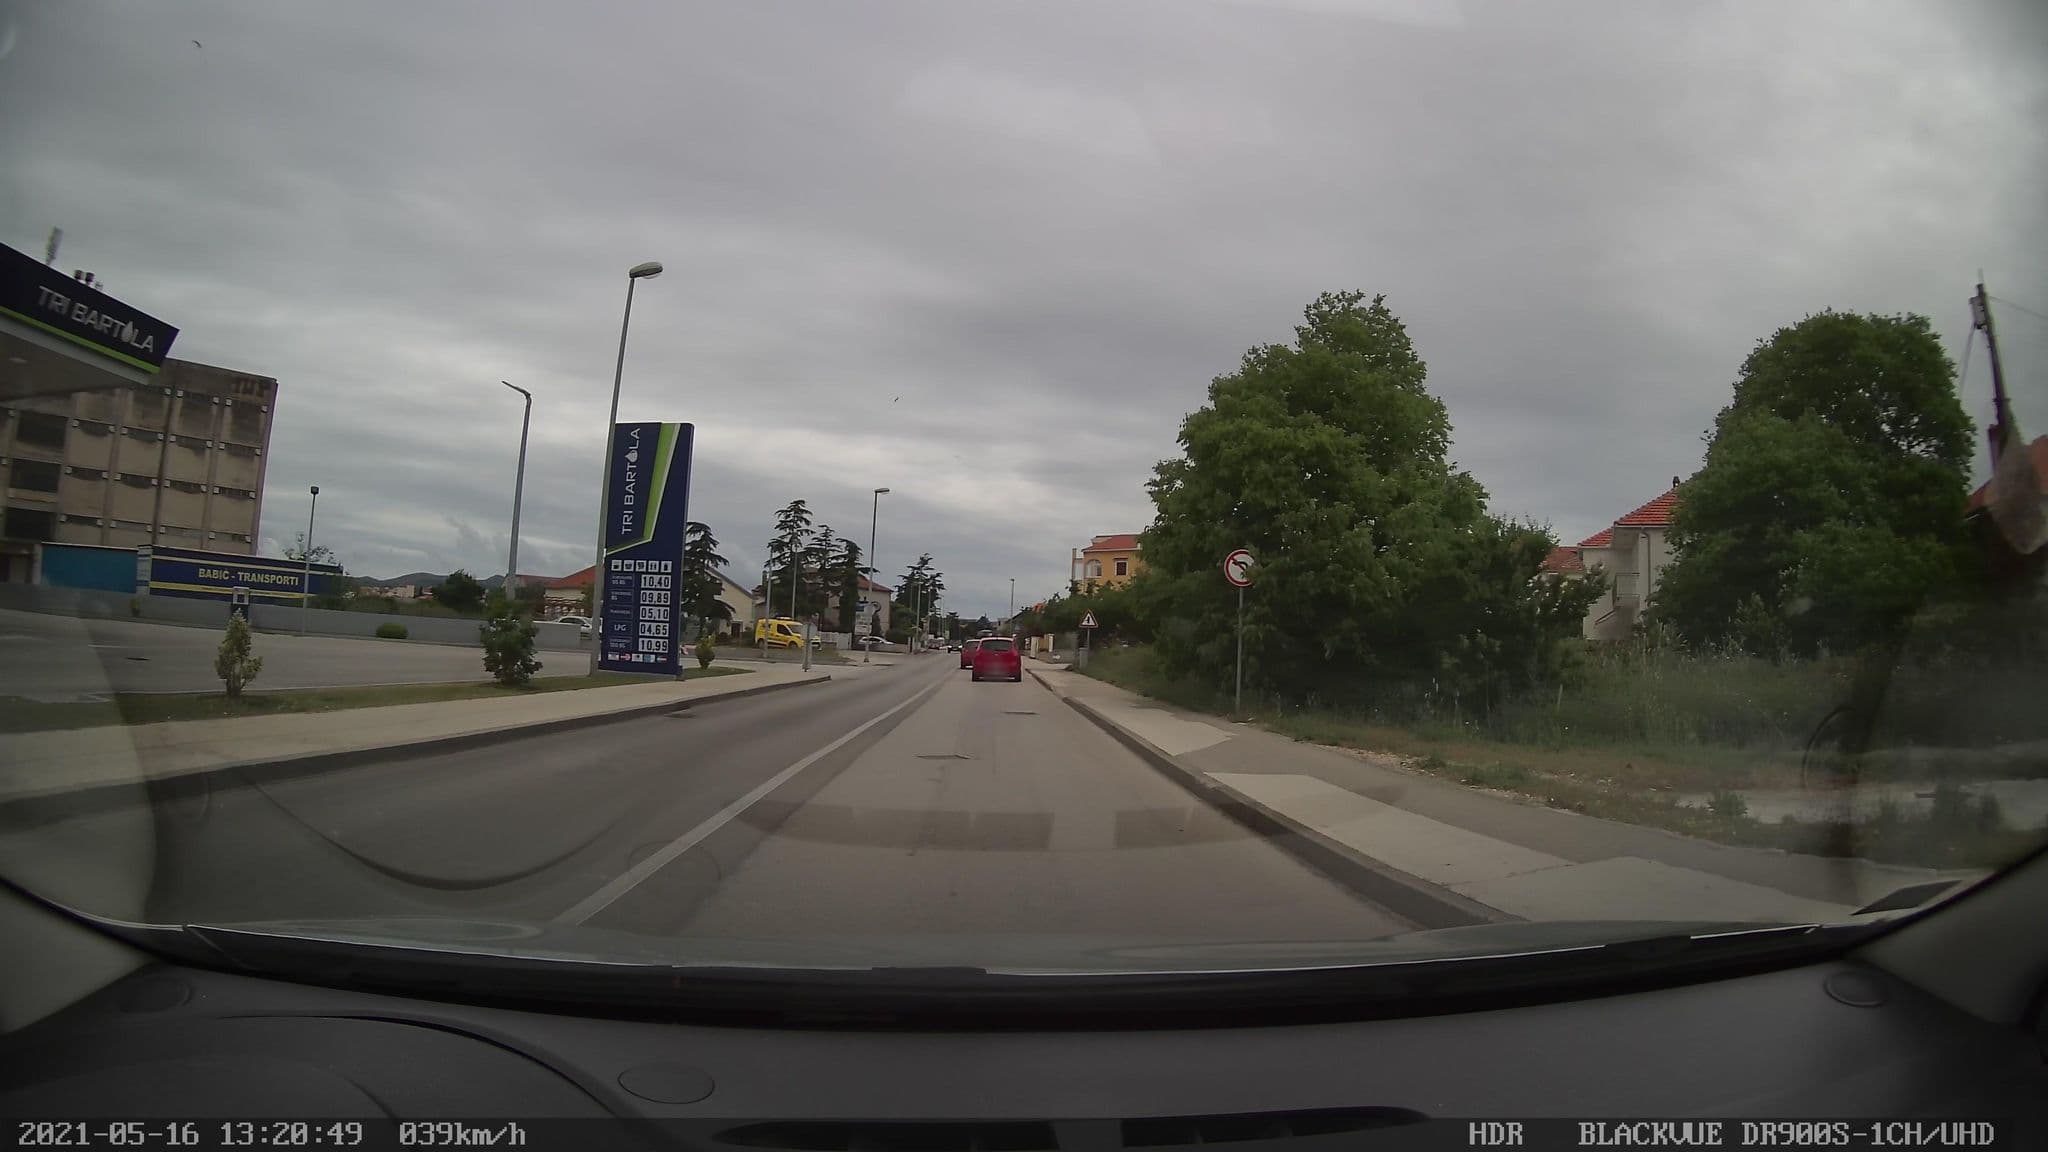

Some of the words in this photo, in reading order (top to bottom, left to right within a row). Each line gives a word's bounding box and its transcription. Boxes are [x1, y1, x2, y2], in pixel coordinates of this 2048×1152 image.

[38, 285, 71, 315] TRI
[621, 510, 633, 535] TRI
[237, 572, 299, 586] TRANSPORTI
[643, 576, 670, 587] 10.40
[641, 592, 669, 604] 09.89
[641, 608, 668, 619] 05.10
[640, 624, 667, 635] 04.65
[640, 639, 668, 651] 10.99
